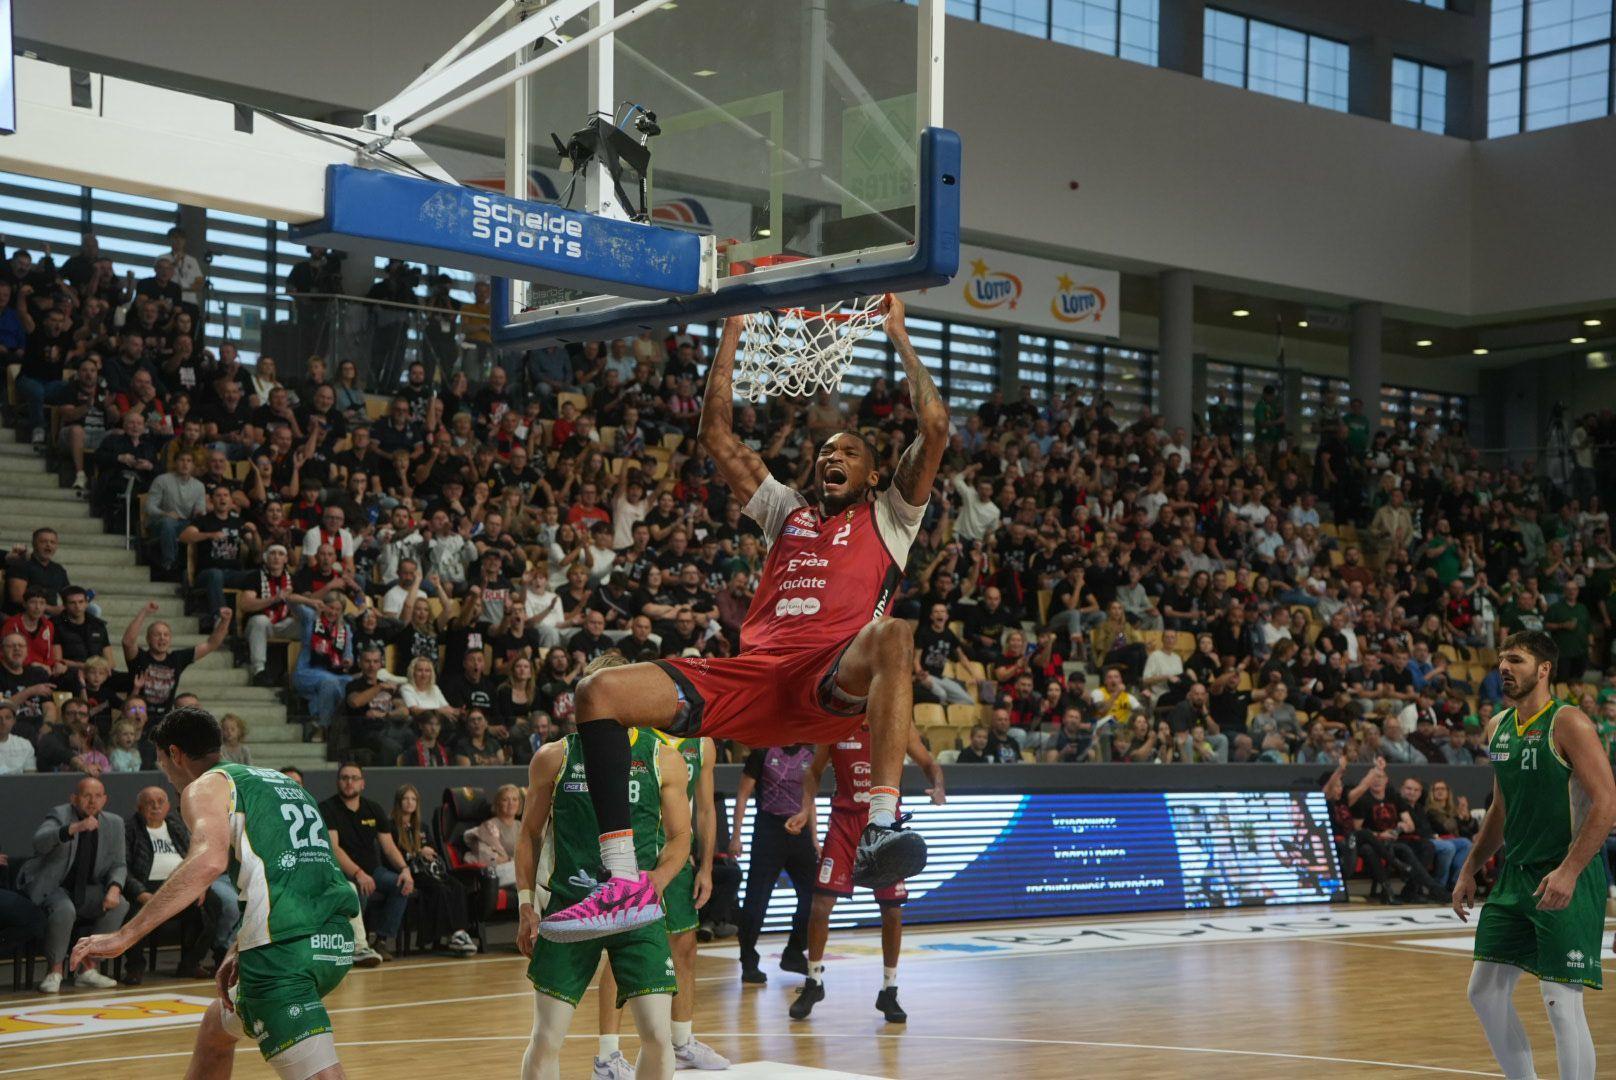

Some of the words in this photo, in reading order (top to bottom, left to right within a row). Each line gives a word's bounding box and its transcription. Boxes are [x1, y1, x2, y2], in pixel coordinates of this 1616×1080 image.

[472, 195, 583, 238] Scheide
[472, 216, 582, 259] Sports
[976, 279, 1011, 300] LOTTO
[1061, 294, 1096, 314] LOTTO
[832, 523, 851, 546] 2
[1520, 748, 1538, 770] 21
[280, 803, 330, 849] 22
[311, 934, 345, 949] BRICO
